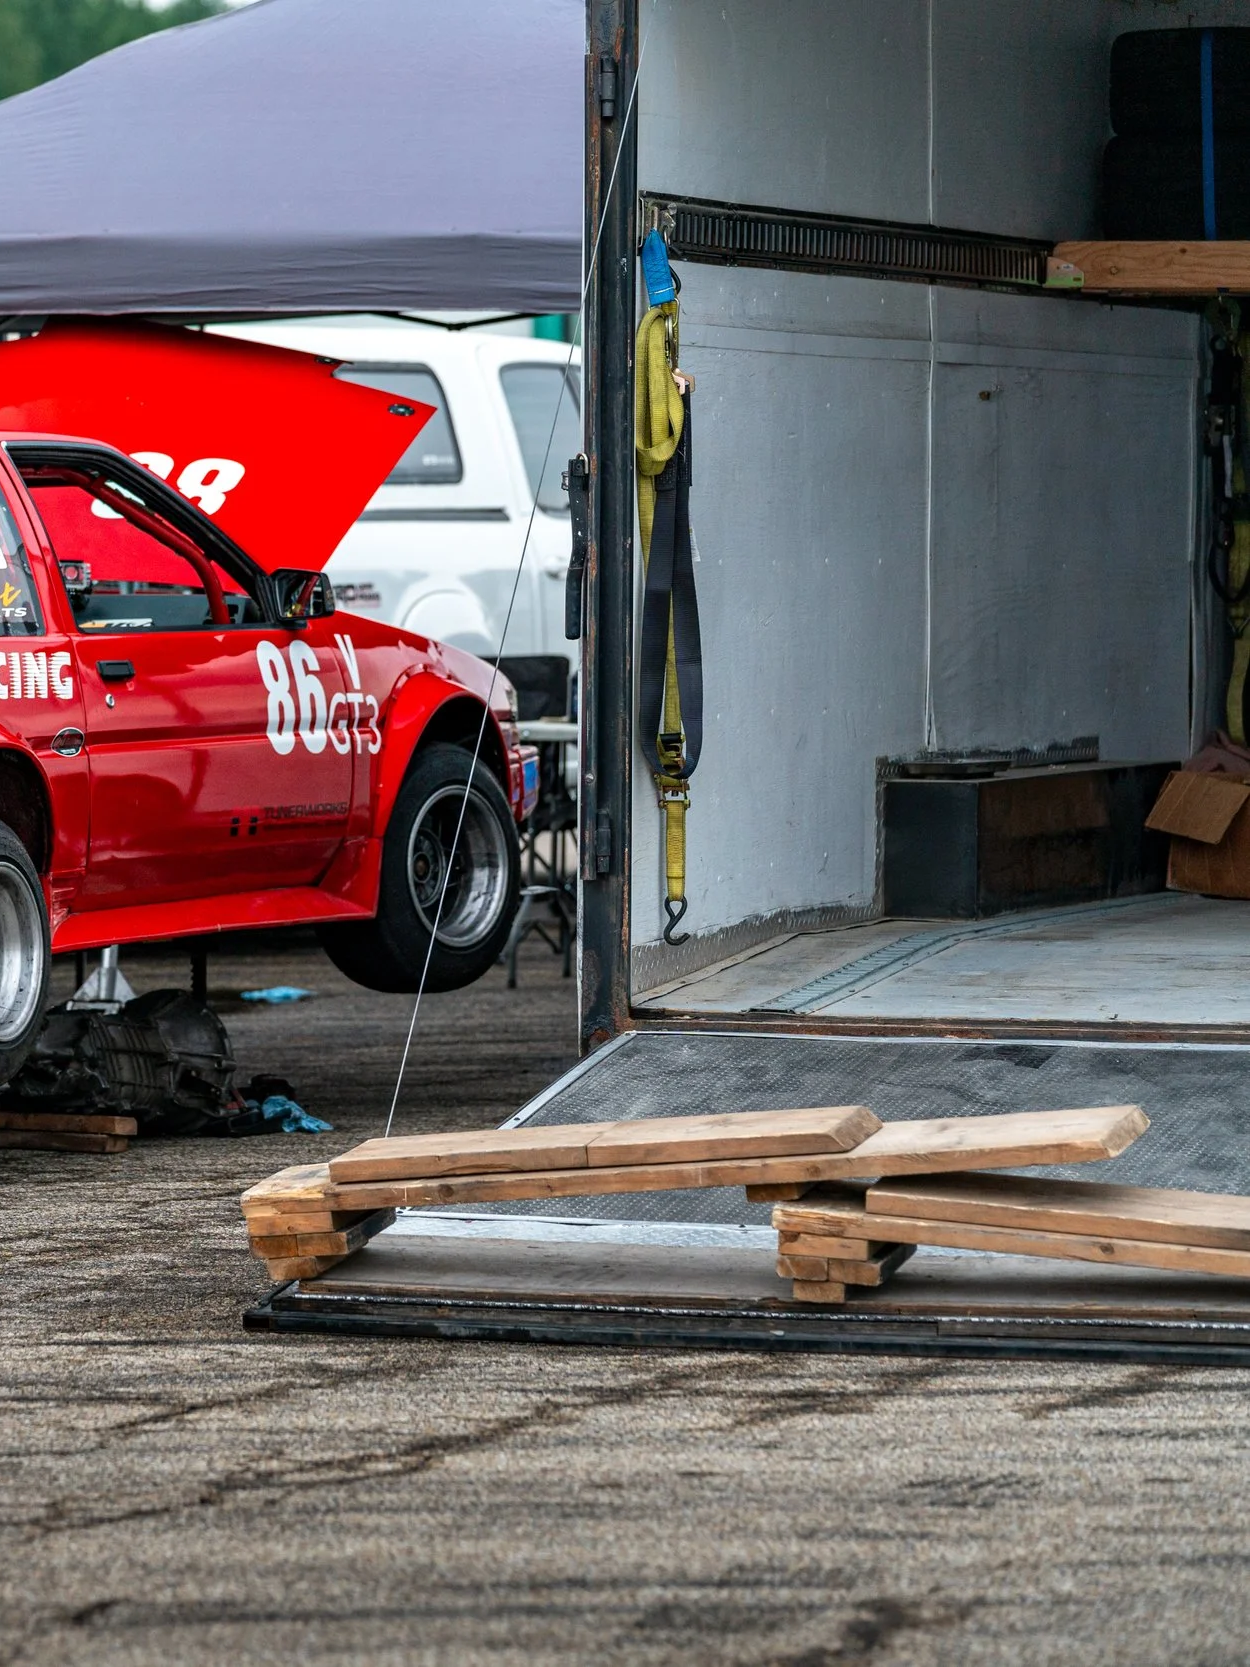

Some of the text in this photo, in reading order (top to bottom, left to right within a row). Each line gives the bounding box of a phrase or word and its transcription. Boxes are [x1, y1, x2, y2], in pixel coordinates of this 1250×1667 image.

[256, 639, 382, 756] 86 GT3
[263, 801, 348, 819] TUNERWORKS
